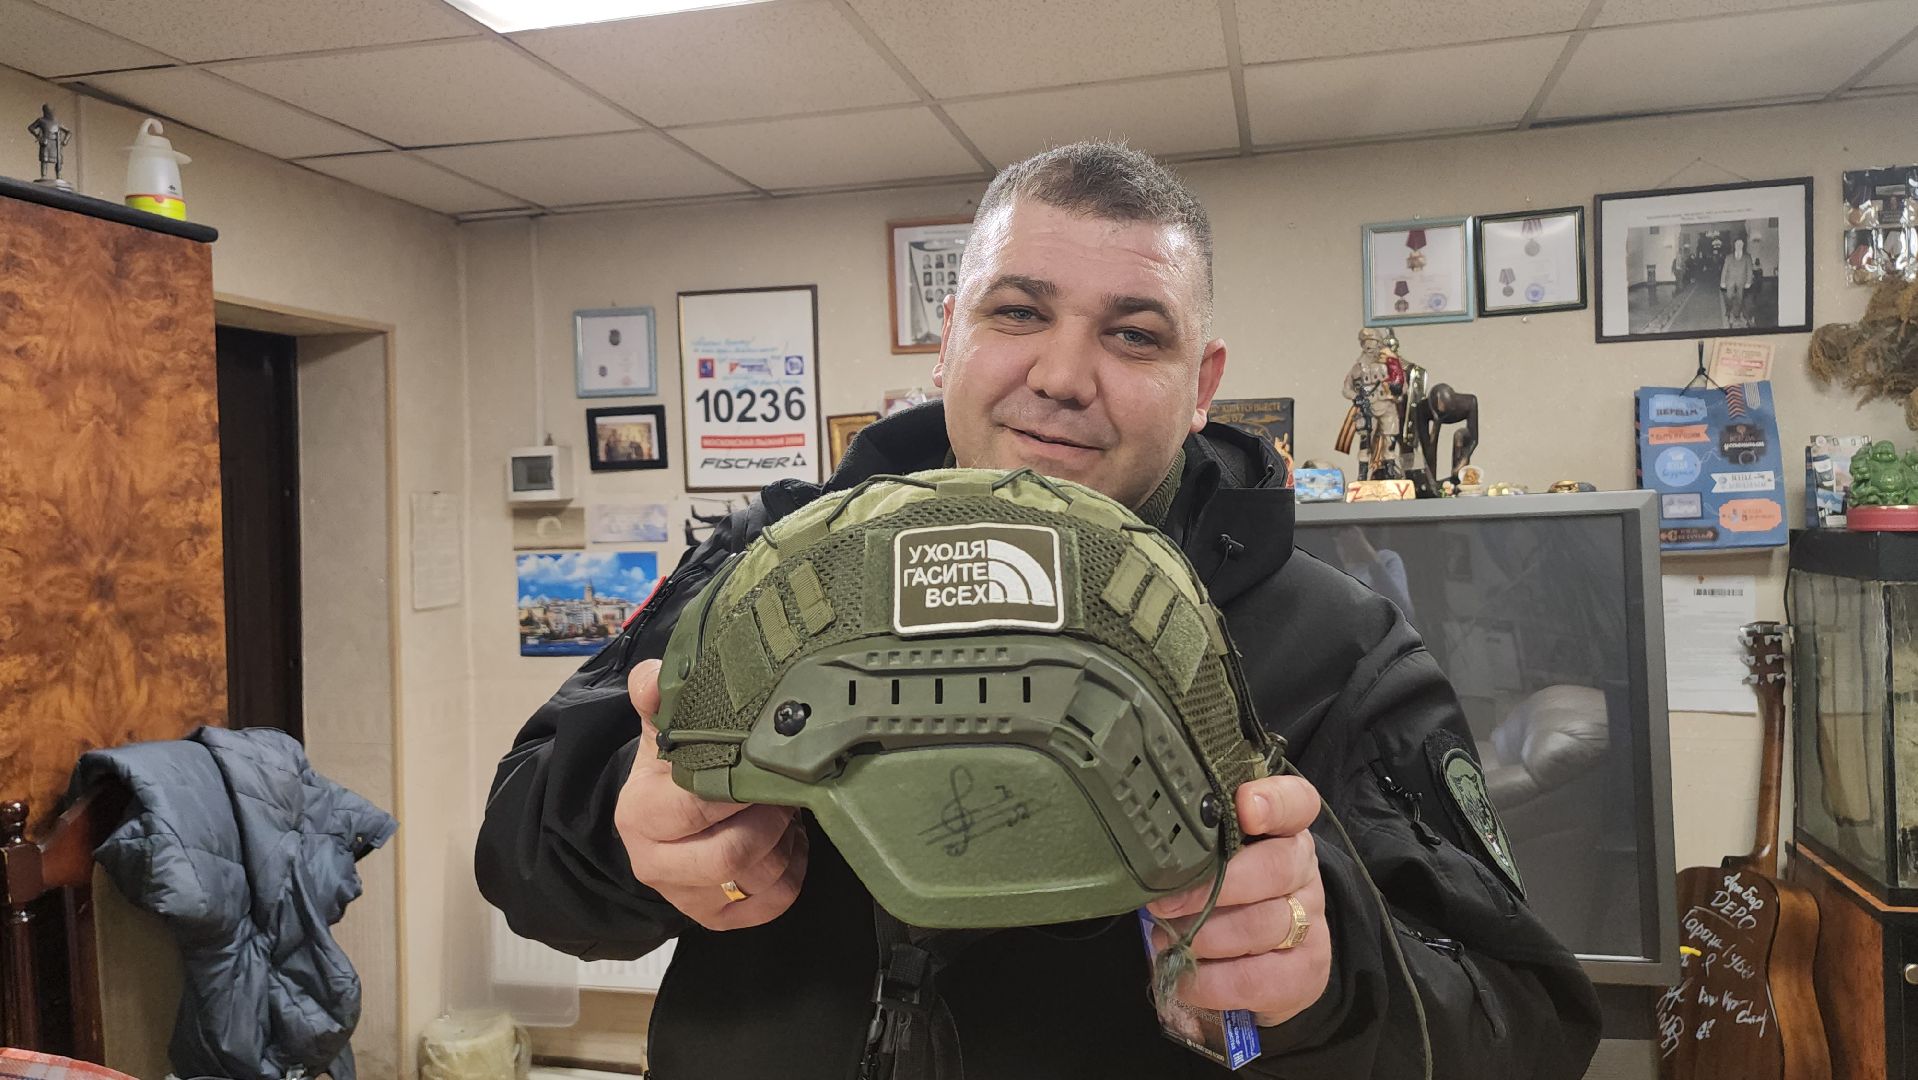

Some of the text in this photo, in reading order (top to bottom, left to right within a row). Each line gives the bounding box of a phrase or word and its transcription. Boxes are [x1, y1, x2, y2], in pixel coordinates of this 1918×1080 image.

[696, 386, 806, 423] 10236
[701, 456, 790, 469] FISCHER
[909, 540, 986, 564] УХОДЯ
[904, 562, 989, 587] ГАСИТЕ
[925, 583, 988, 608] ВСЕХ
